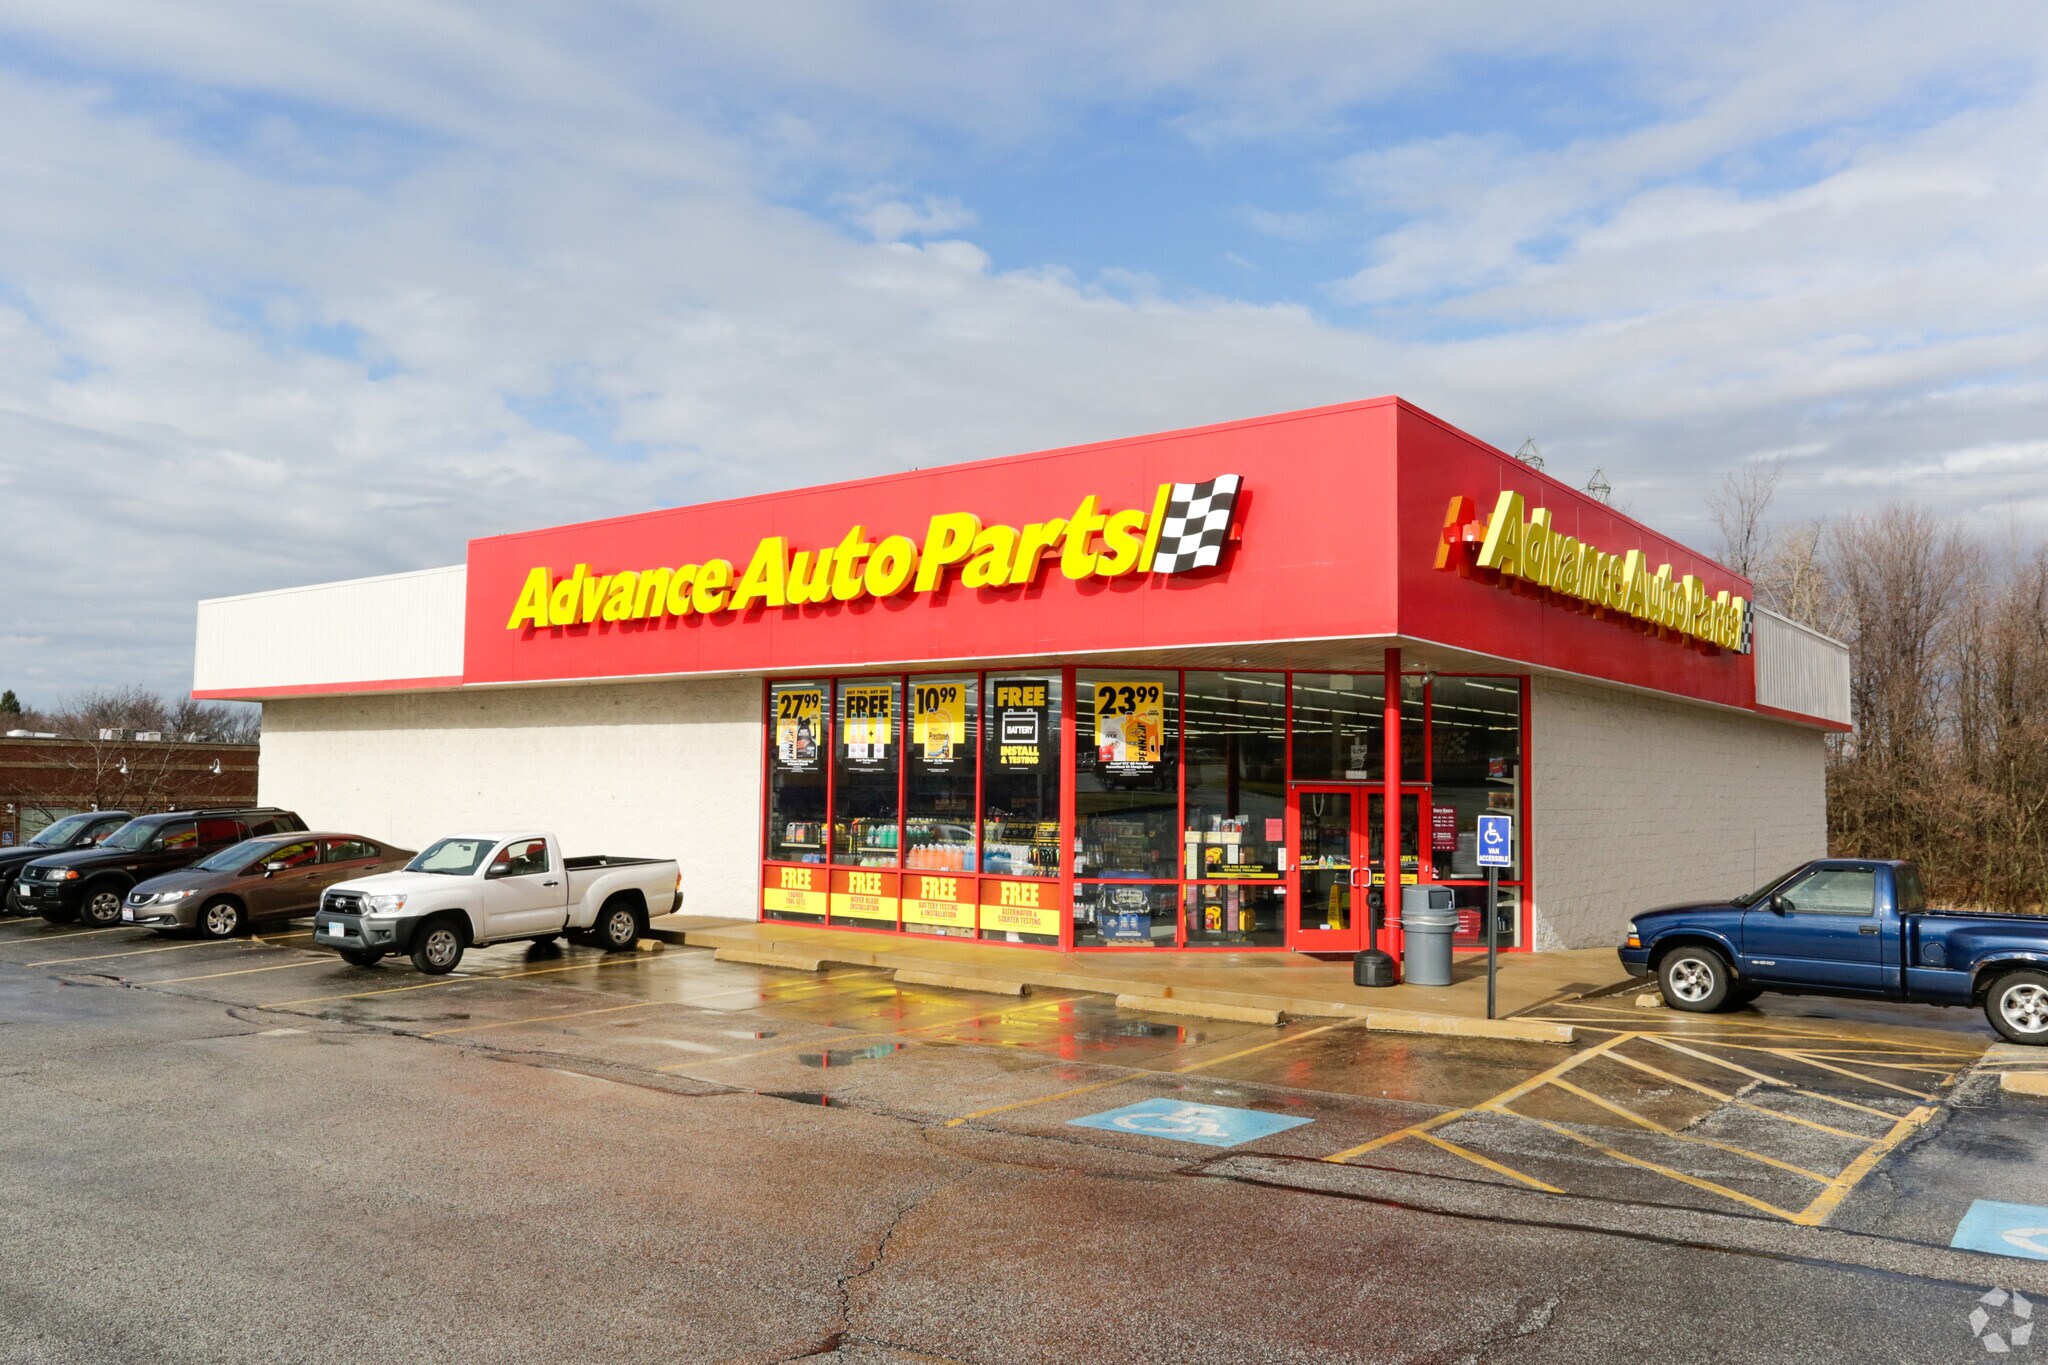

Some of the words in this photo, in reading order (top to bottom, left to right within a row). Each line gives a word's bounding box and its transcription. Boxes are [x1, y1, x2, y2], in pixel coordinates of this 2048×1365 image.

[506, 558, 734, 629] Advance
[727, 525, 918, 610] Auto
[914, 494, 1150, 592] Parts
[1476, 490, 1625, 611] Advance
[1623, 549, 1688, 631] Auto
[1683, 575, 1741, 650] Parts
[997, 686, 1046, 707] FREE
[846, 695, 889, 718] FREE
[1006, 726, 1033, 734] BATTERY
[1000, 745, 1039, 756] INSTALL
[1000, 756, 1007, 764] &
[1008, 756, 1039, 765] TESTING
[780, 867, 812, 890] FREE
[848, 871, 882, 895] FREE
[920, 876, 957, 901] FREE
[1000, 881, 1039, 907] FREE
[850, 896, 865, 904] WIPER
[865, 897, 880, 905] BLADE
[918, 901, 938, 909] BATTERY
[939, 903, 958, 911] TESTING
[850, 903, 879, 912] INSTALLATION
[1001, 908, 1033, 917] ALTERNATOR
[924, 909, 957, 918] INSTALLATION
[997, 915, 1019, 924] STARTER
[1020, 917, 1041, 926] TESTING
